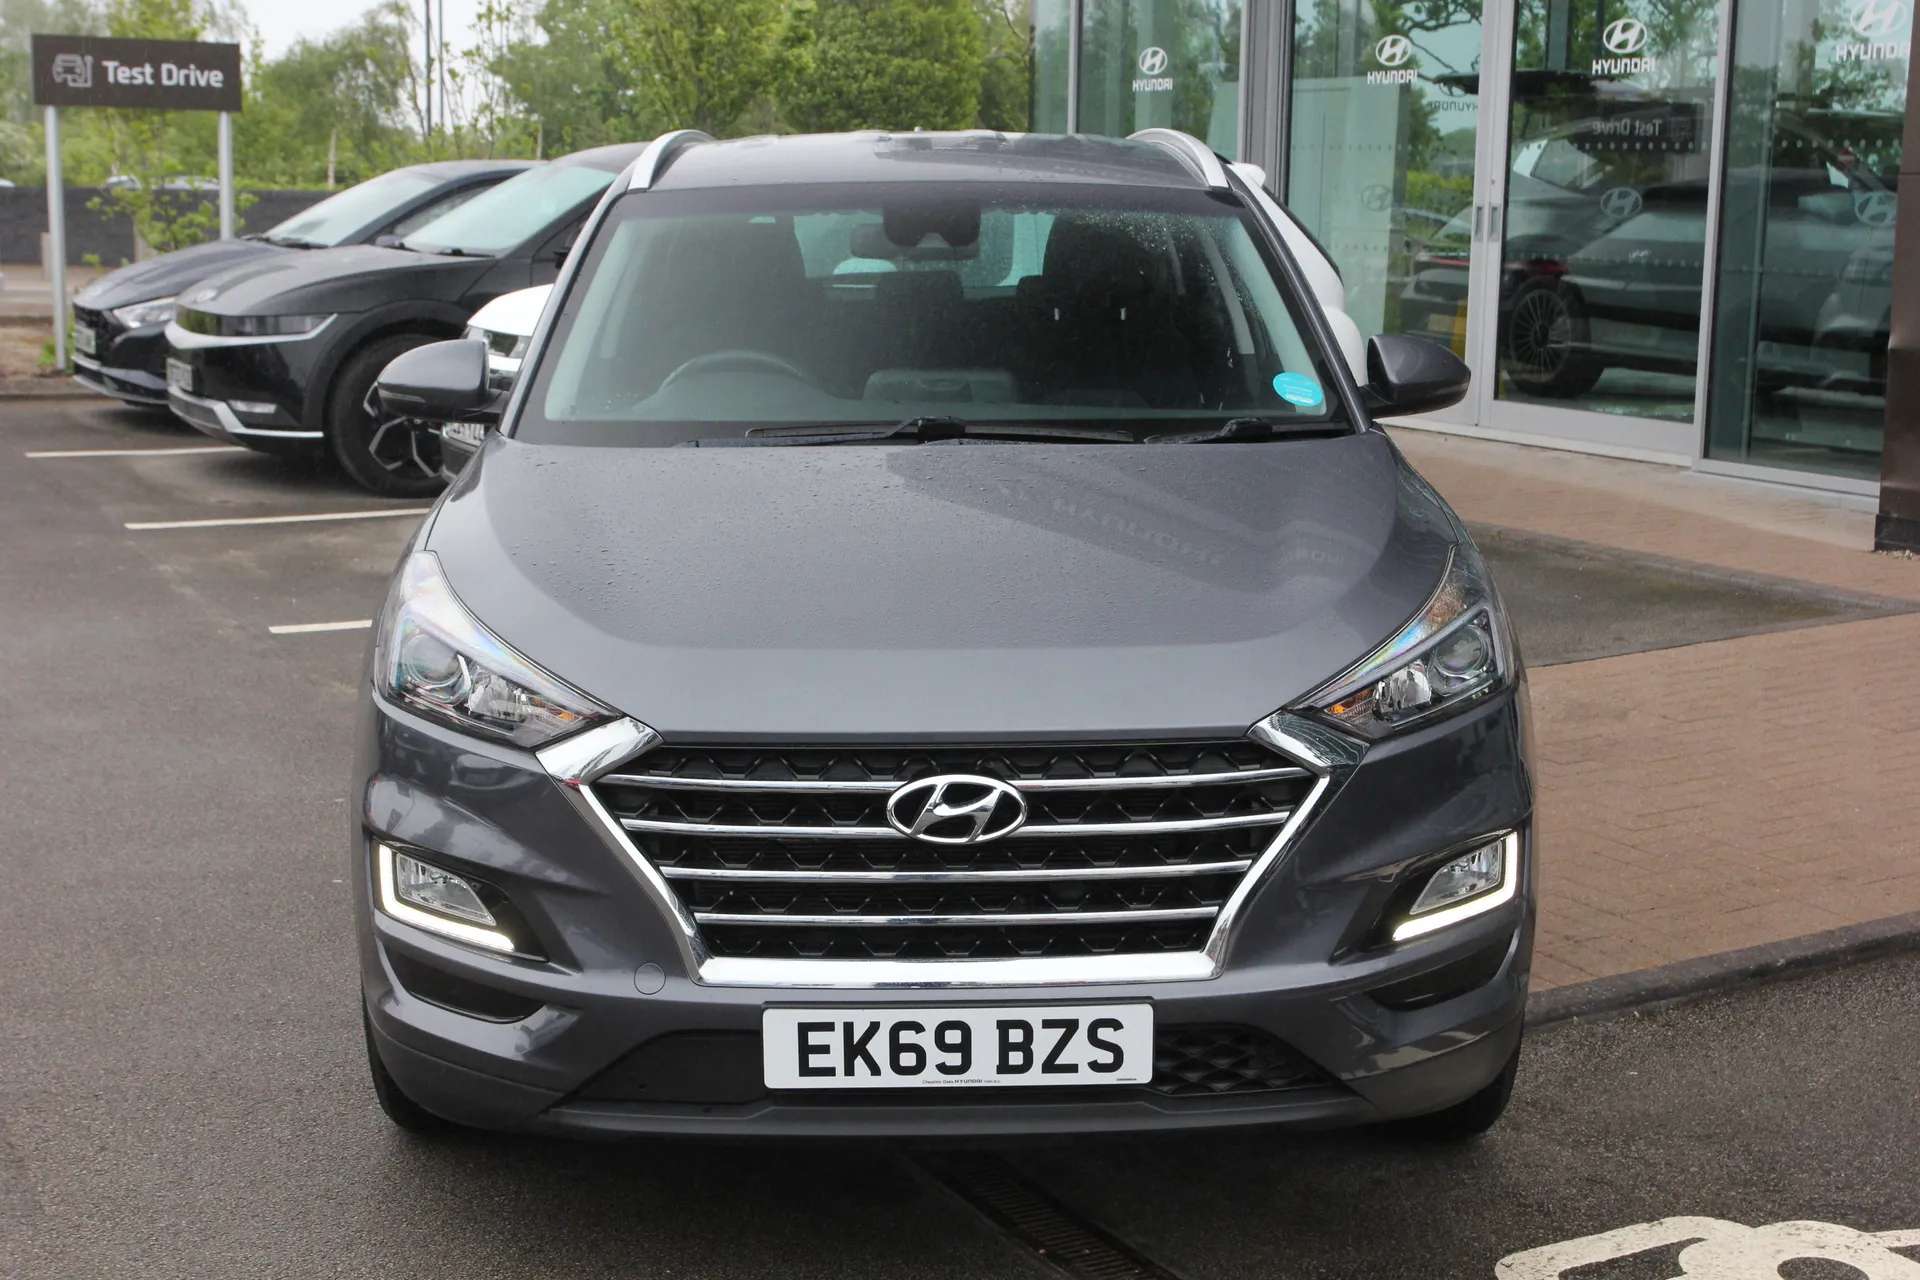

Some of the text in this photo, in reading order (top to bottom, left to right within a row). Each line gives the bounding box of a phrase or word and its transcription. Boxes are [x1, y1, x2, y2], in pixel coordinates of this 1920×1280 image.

[1835, 43, 1909, 62] HYUND
[101, 60, 225, 88] Test Drive
[1592, 57, 1656, 75] HYUNDAI
[1132, 78, 1173, 92] HYUNDAI
[1367, 69, 1417, 85] HYUNDAI
[797, 1018, 1124, 1077] EK69 BZS
